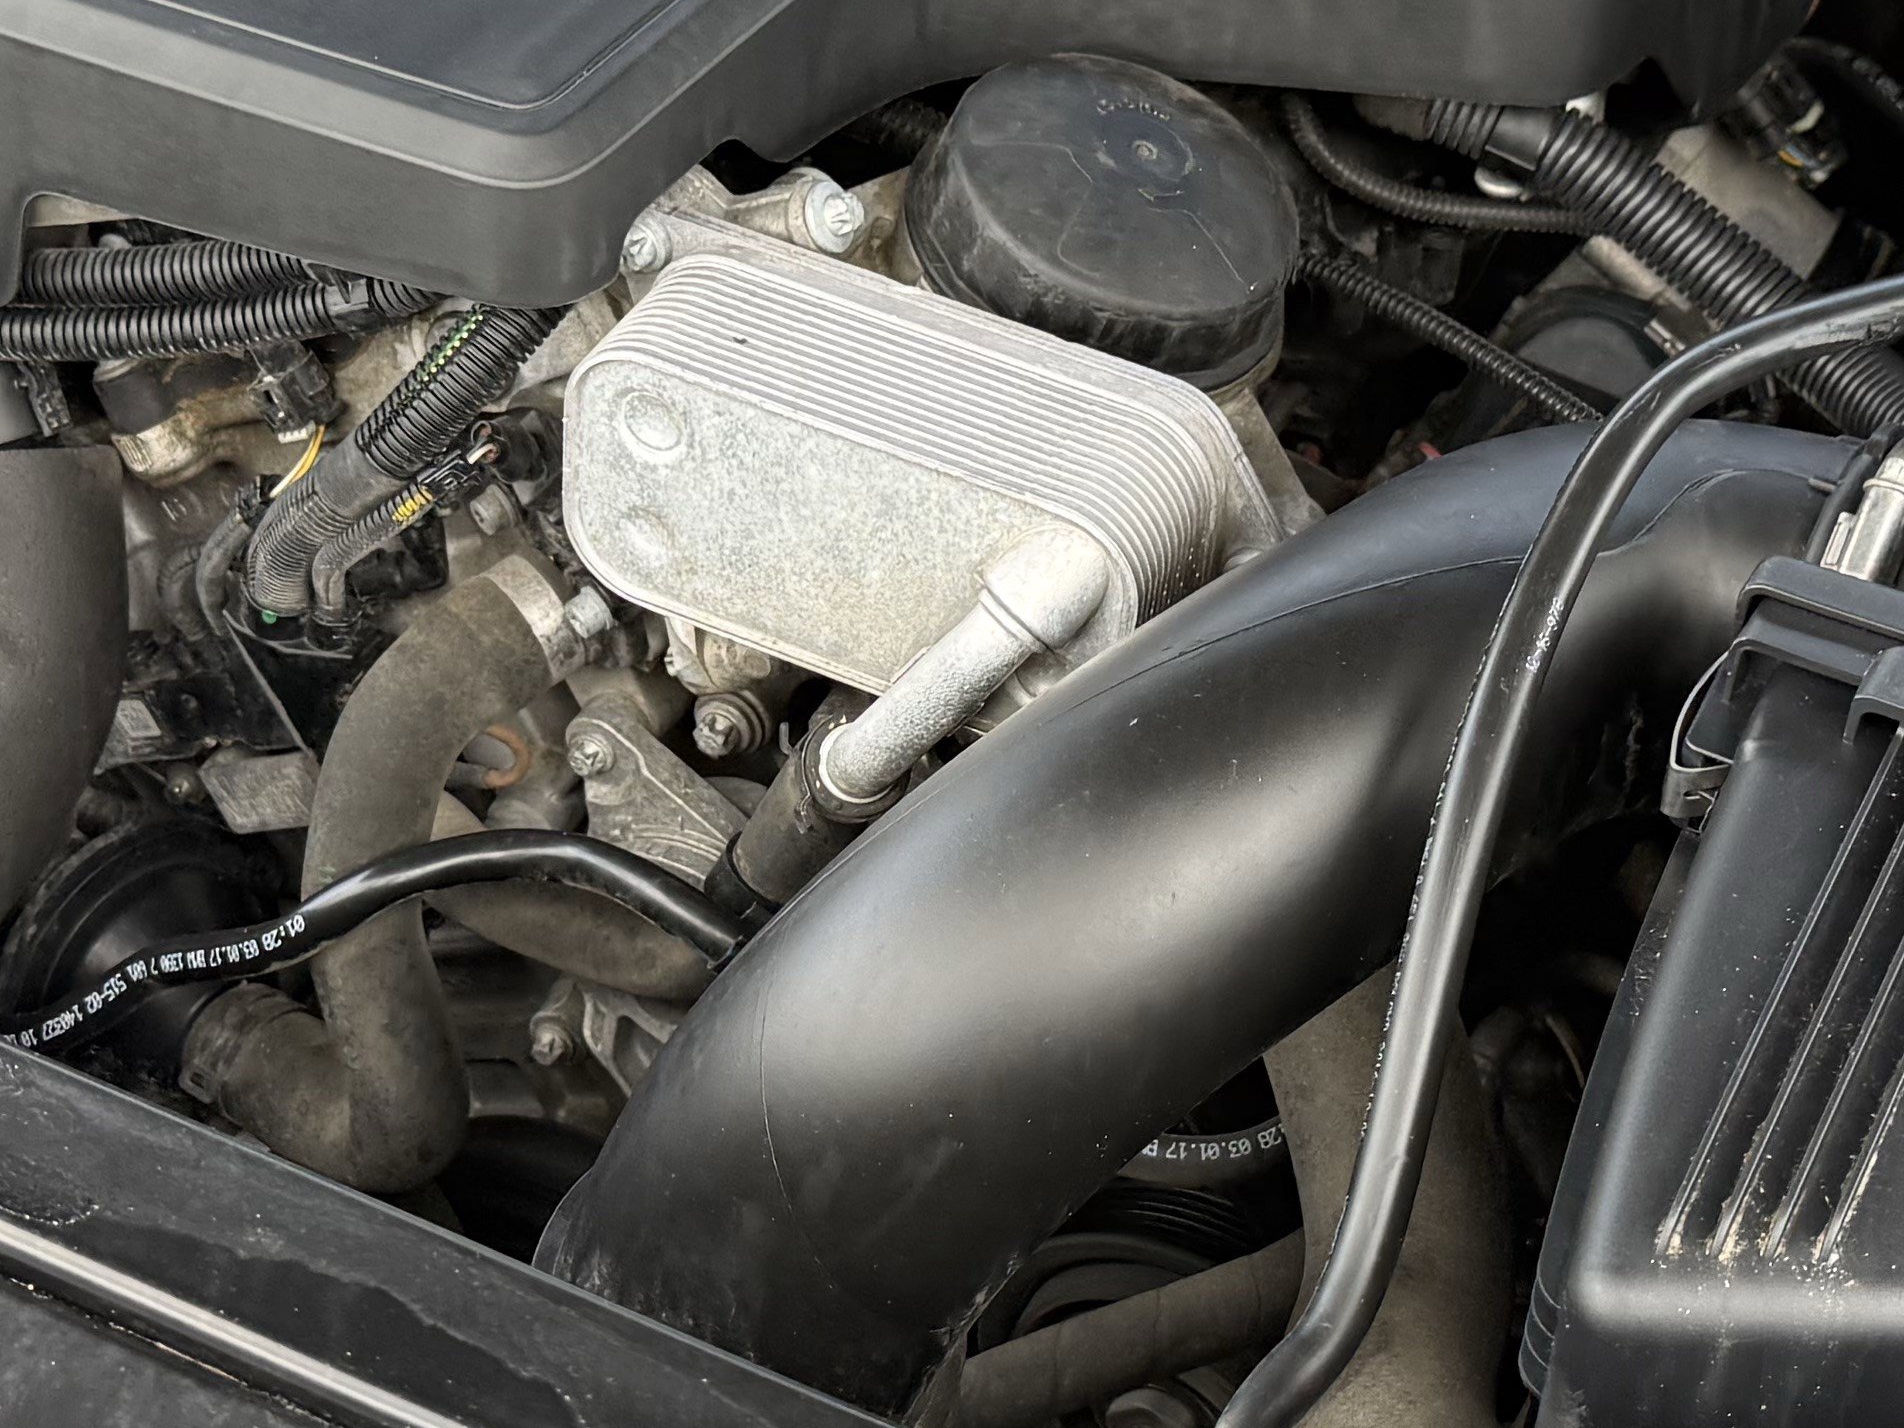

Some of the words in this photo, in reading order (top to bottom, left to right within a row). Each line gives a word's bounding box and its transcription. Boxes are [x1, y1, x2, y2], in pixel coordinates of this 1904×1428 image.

[262, 914, 305, 951] 01:28
[209, 938, 260, 967] 03.01.17
[1165, 1137, 1252, 1161] 03.01.17
